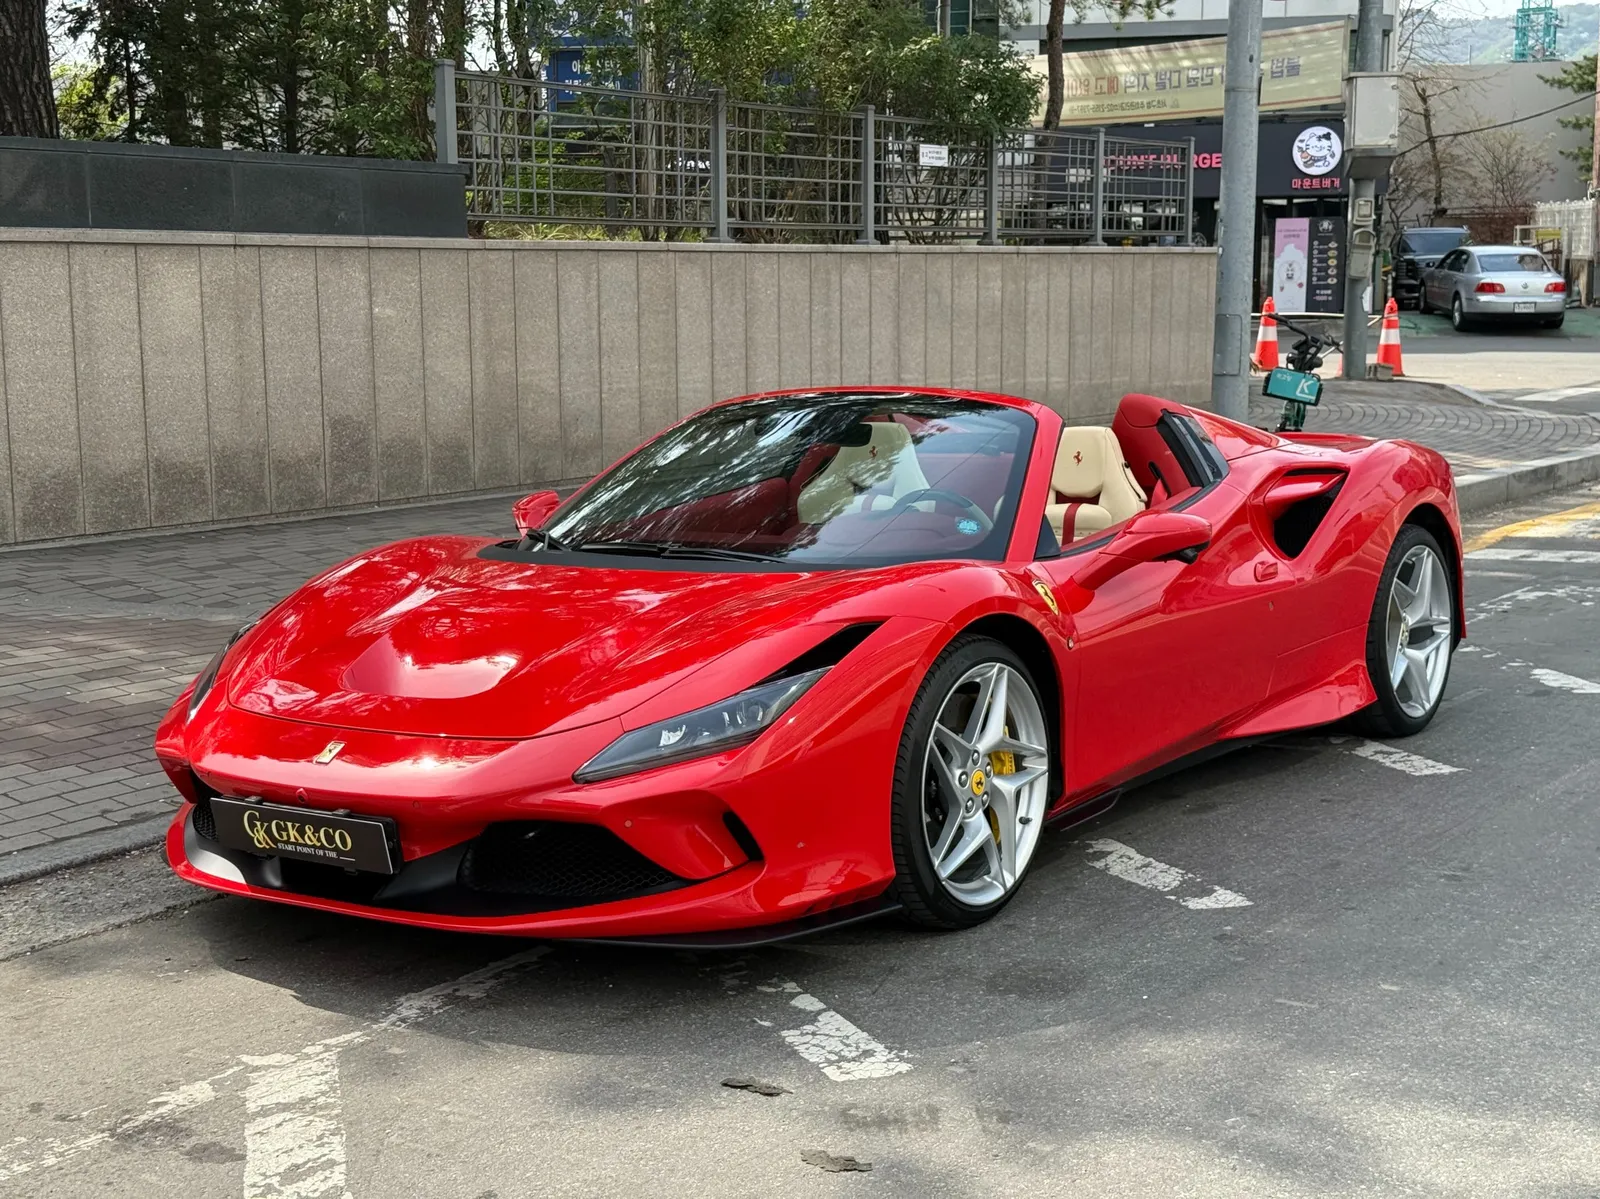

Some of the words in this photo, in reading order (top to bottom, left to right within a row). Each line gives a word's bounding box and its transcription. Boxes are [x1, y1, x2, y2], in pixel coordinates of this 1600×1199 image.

[1103, 152, 1158, 171] OUNT
[1291, 177, 1341, 189] 마운트버거
[271, 819, 352, 851] GK&CO
[277, 843, 296, 852] START
[296, 845, 316, 855] POINT
[316, 848, 325, 856] OF
[325, 849, 338, 859] THE
